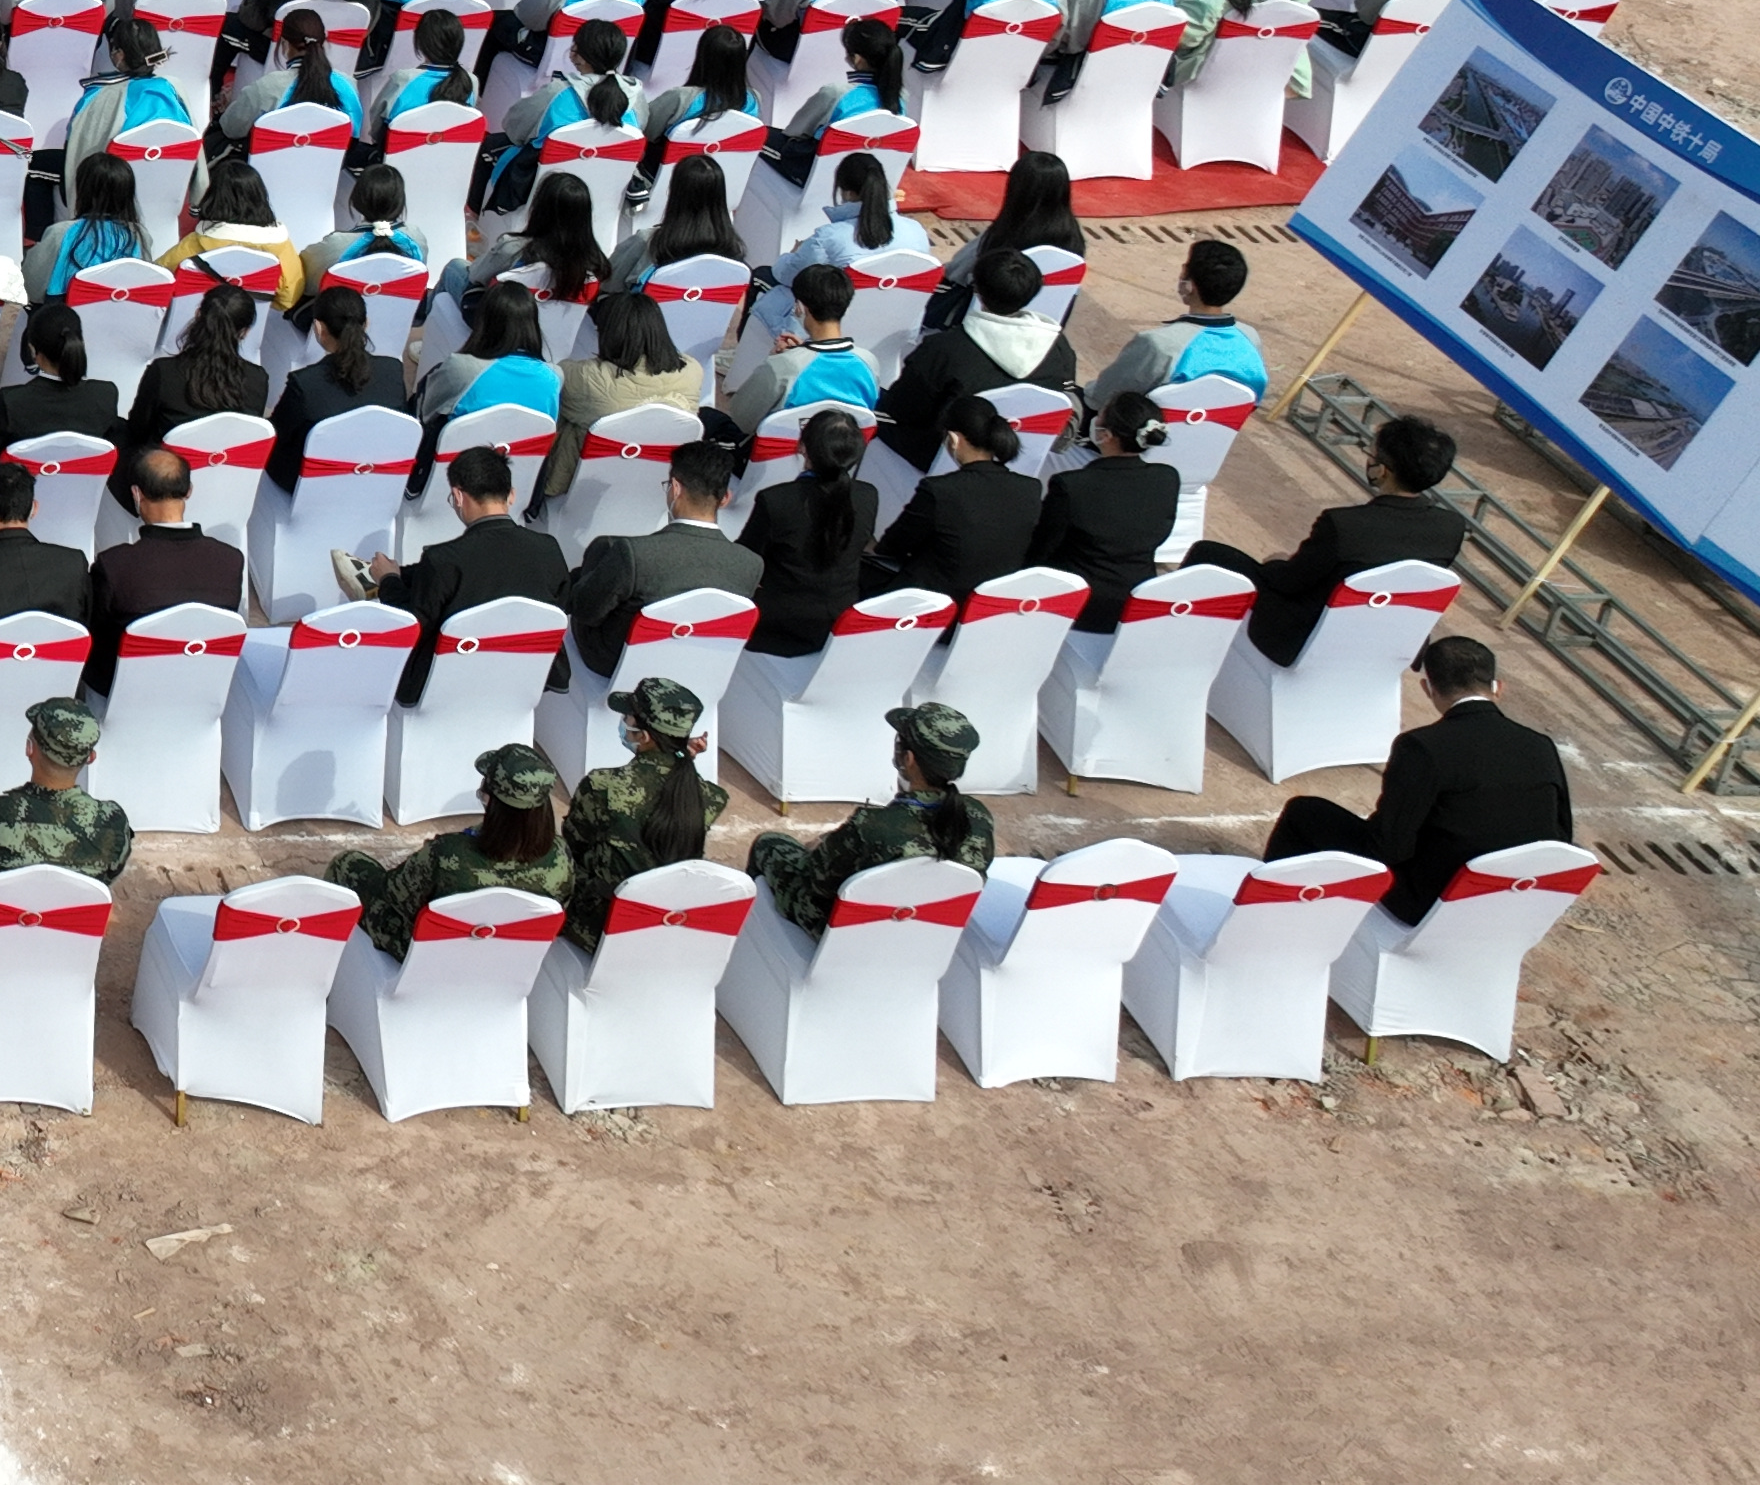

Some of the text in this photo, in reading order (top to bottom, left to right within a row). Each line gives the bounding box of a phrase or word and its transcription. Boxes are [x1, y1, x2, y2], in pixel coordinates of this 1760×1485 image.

[1629, 94, 1723, 164] 中国中铁十局
